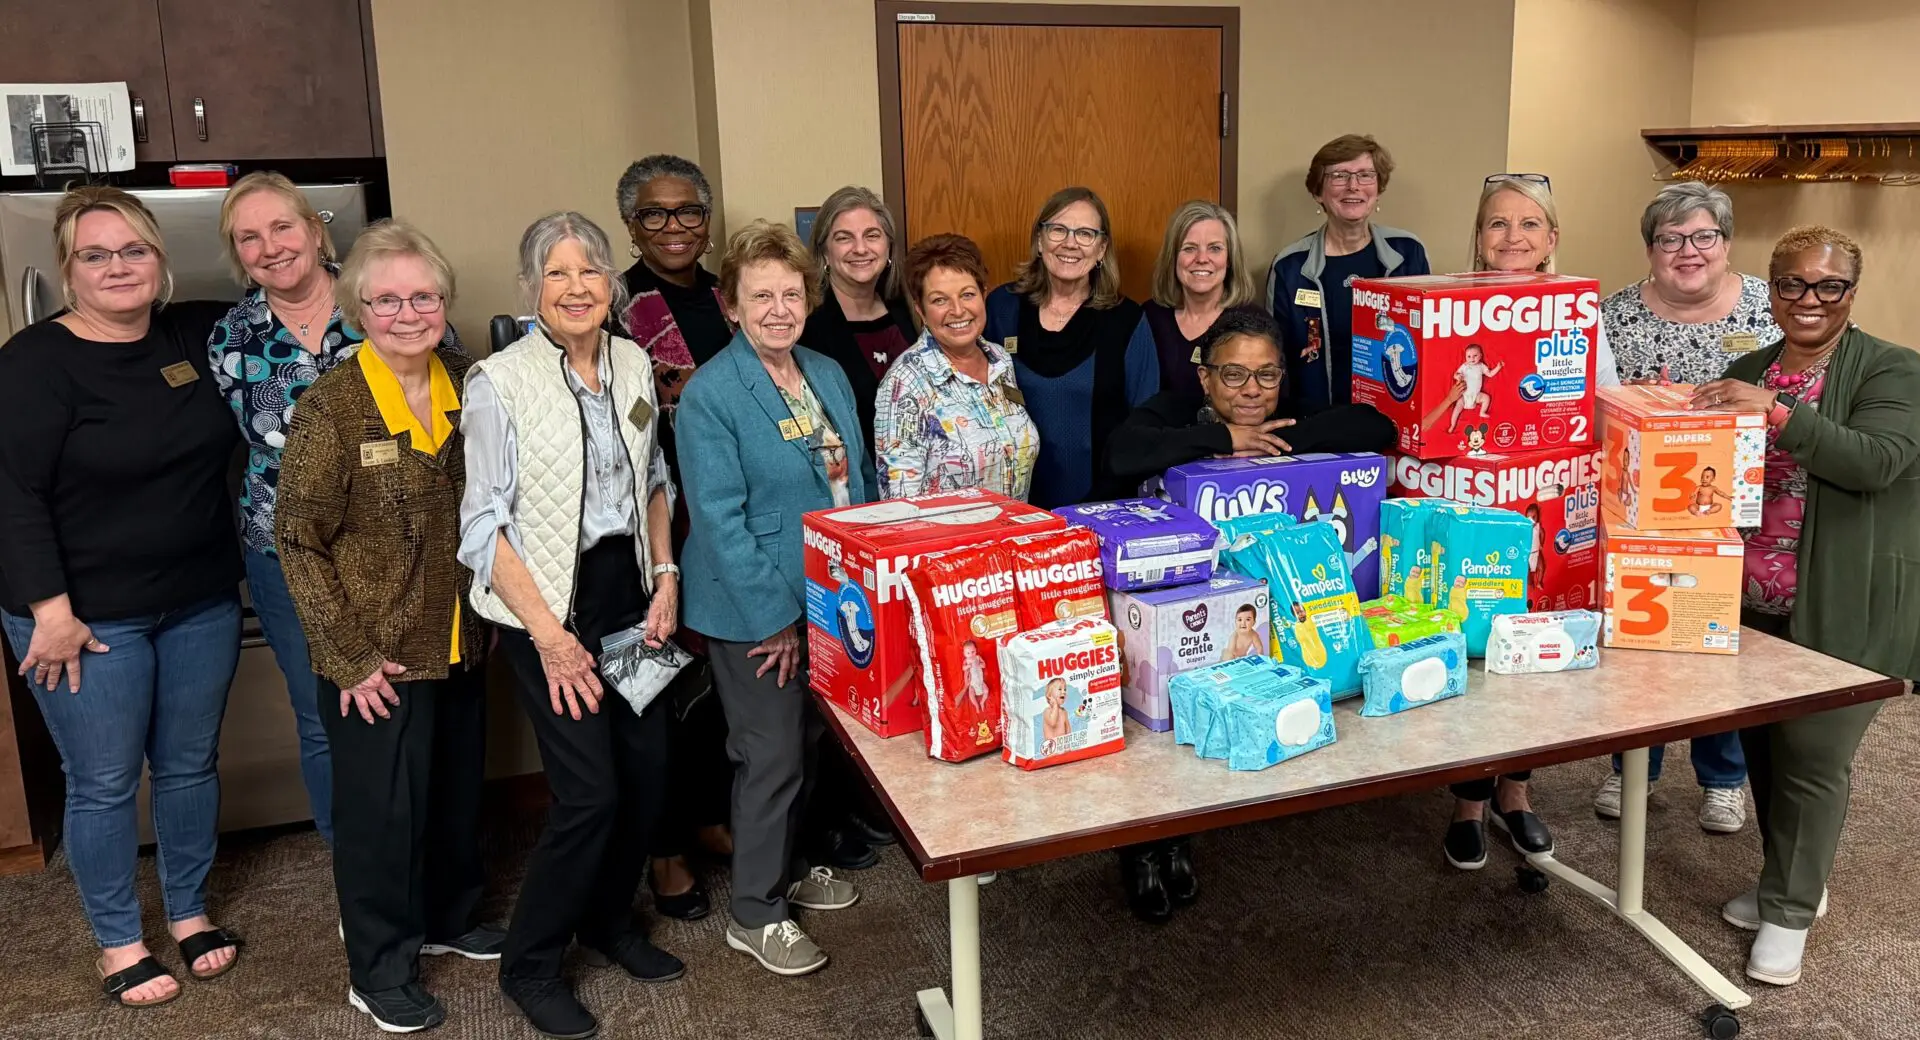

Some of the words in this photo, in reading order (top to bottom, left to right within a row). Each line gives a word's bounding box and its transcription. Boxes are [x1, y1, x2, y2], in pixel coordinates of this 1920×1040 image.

[1353, 288, 1390, 312] HUGGIES
[1422, 291, 1599, 340] HUGGIES
[1552, 358, 1573, 368] little
[1412, 423, 1419, 441] 2
[1568, 415, 1588, 442] 2
[1663, 433, 1712, 444] DIAPERS
[1605, 423, 1624, 496] 3
[1386, 455, 1495, 506] GGIES
[1498, 452, 1602, 504] HUGGIES
[1653, 452, 1698, 513] 3
[803, 524, 843, 563] HUGGIES
[1461, 557, 1512, 578] Pampers
[1621, 557, 1673, 568] DIAPERS
[1016, 557, 1104, 592] HUGGIES
[932, 570, 1014, 608] HUGGIES
[1040, 590, 1062, 601] little
[1063, 582, 1102, 595] snugglers
[1291, 577, 1345, 599] Pampers
[1588, 579, 1597, 606] 1
[956, 604, 977, 617] little
[978, 595, 1014, 611] snugglers
[1185, 608, 1207, 624] Parent's
[1308, 599, 1344, 612] swaddlers
[1619, 575, 1670, 636] 3
[1270, 599, 1287, 643] ampers
[1181, 635, 1200, 646] Dry
[1203, 632, 1210, 642] &
[1178, 643, 1214, 658] Gentle
[1186, 655, 1206, 664] Diapers
[1037, 644, 1115, 680] HUGGIES
[1068, 669, 1095, 682] simply
[1096, 664, 1116, 675] clean
[873, 697, 881, 718] 2
